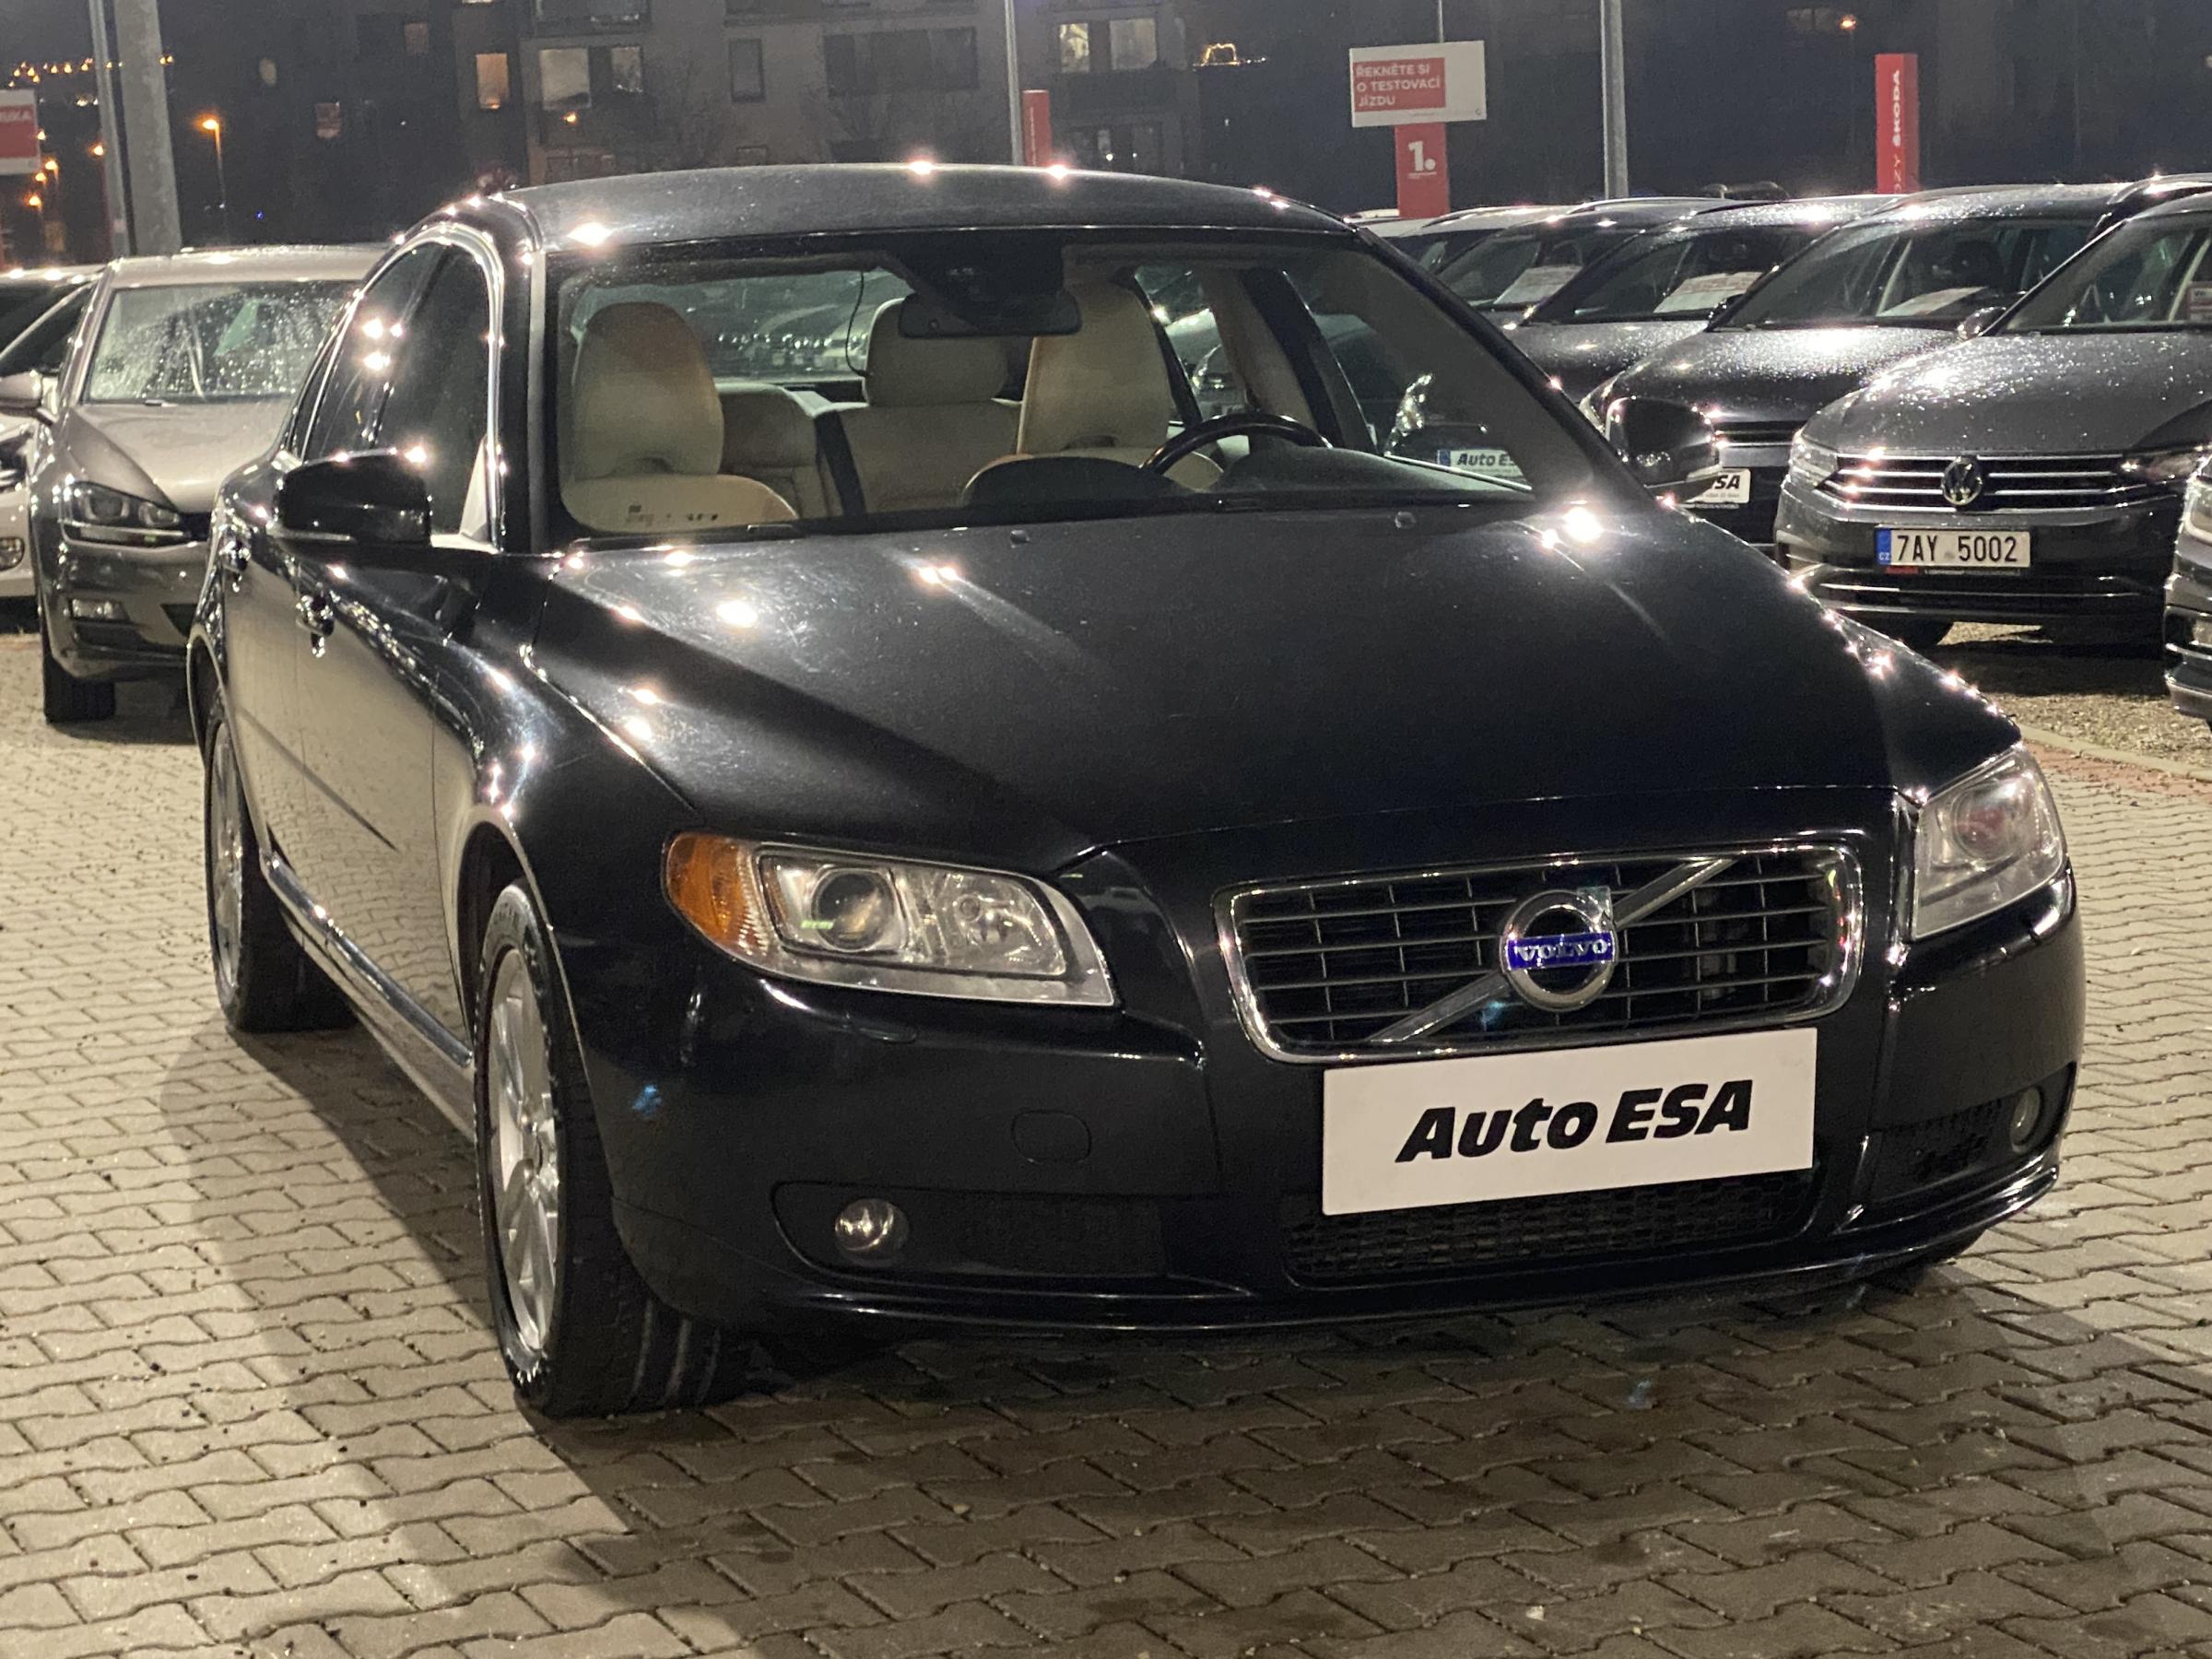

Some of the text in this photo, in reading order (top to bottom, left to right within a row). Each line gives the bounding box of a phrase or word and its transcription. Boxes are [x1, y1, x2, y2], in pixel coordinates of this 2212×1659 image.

[1356, 64, 1430, 76] ŘEKNĚTE SI
[1357, 76, 1440, 92] O TESTOVACÍ
[1359, 94, 1395, 107] JÍZDU
[1408, 140, 1436, 171] 1.
[1457, 453, 1496, 466] Auto
[1714, 475, 1740, 489] SA
[1897, 535, 1938, 561] 7AY
[1958, 535, 2018, 562] 5002
[1514, 938, 1609, 962] VOLVO
[1394, 1078, 1753, 1164] Auto ESA
